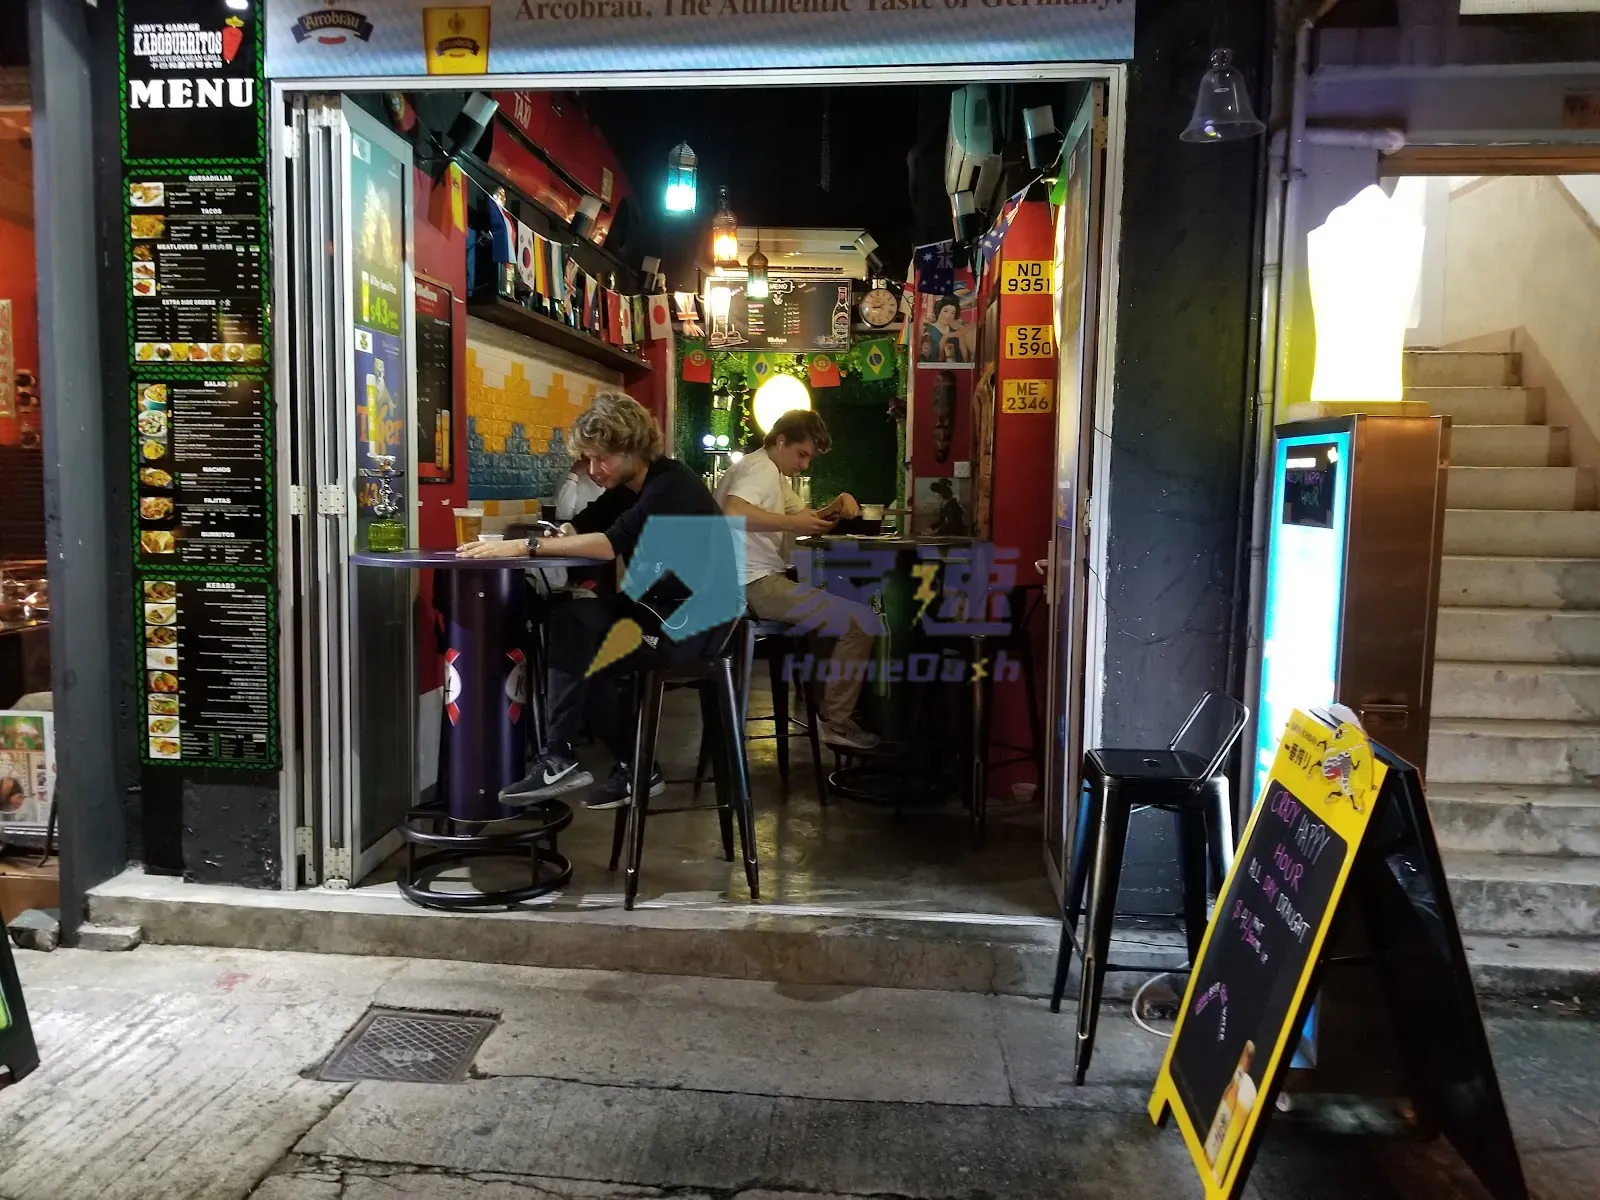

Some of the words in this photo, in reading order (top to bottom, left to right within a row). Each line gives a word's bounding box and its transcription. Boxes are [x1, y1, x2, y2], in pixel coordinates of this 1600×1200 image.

[133, 23, 165, 32] ANDY'S
[165, 22, 200, 32] GARAGE
[133, 31, 222, 56] KABOBURRITOS
[128, 78, 255, 109] MENU
[1018, 263, 1042, 277] ND
[1007, 278, 1050, 292] 9351
[1017, 327, 1042, 341] SZ
[1009, 342, 1051, 356] 1590
[1016, 382, 1039, 396] ME
[1006, 397, 1049, 410] 2346
[356, 404, 404, 455] Tger
[205, 581, 236, 590] KEBABS
[1270, 790, 1302, 828] CRAZY
[1294, 814, 1330, 864] HAPPY
[1273, 843, 1304, 892] HOUR
